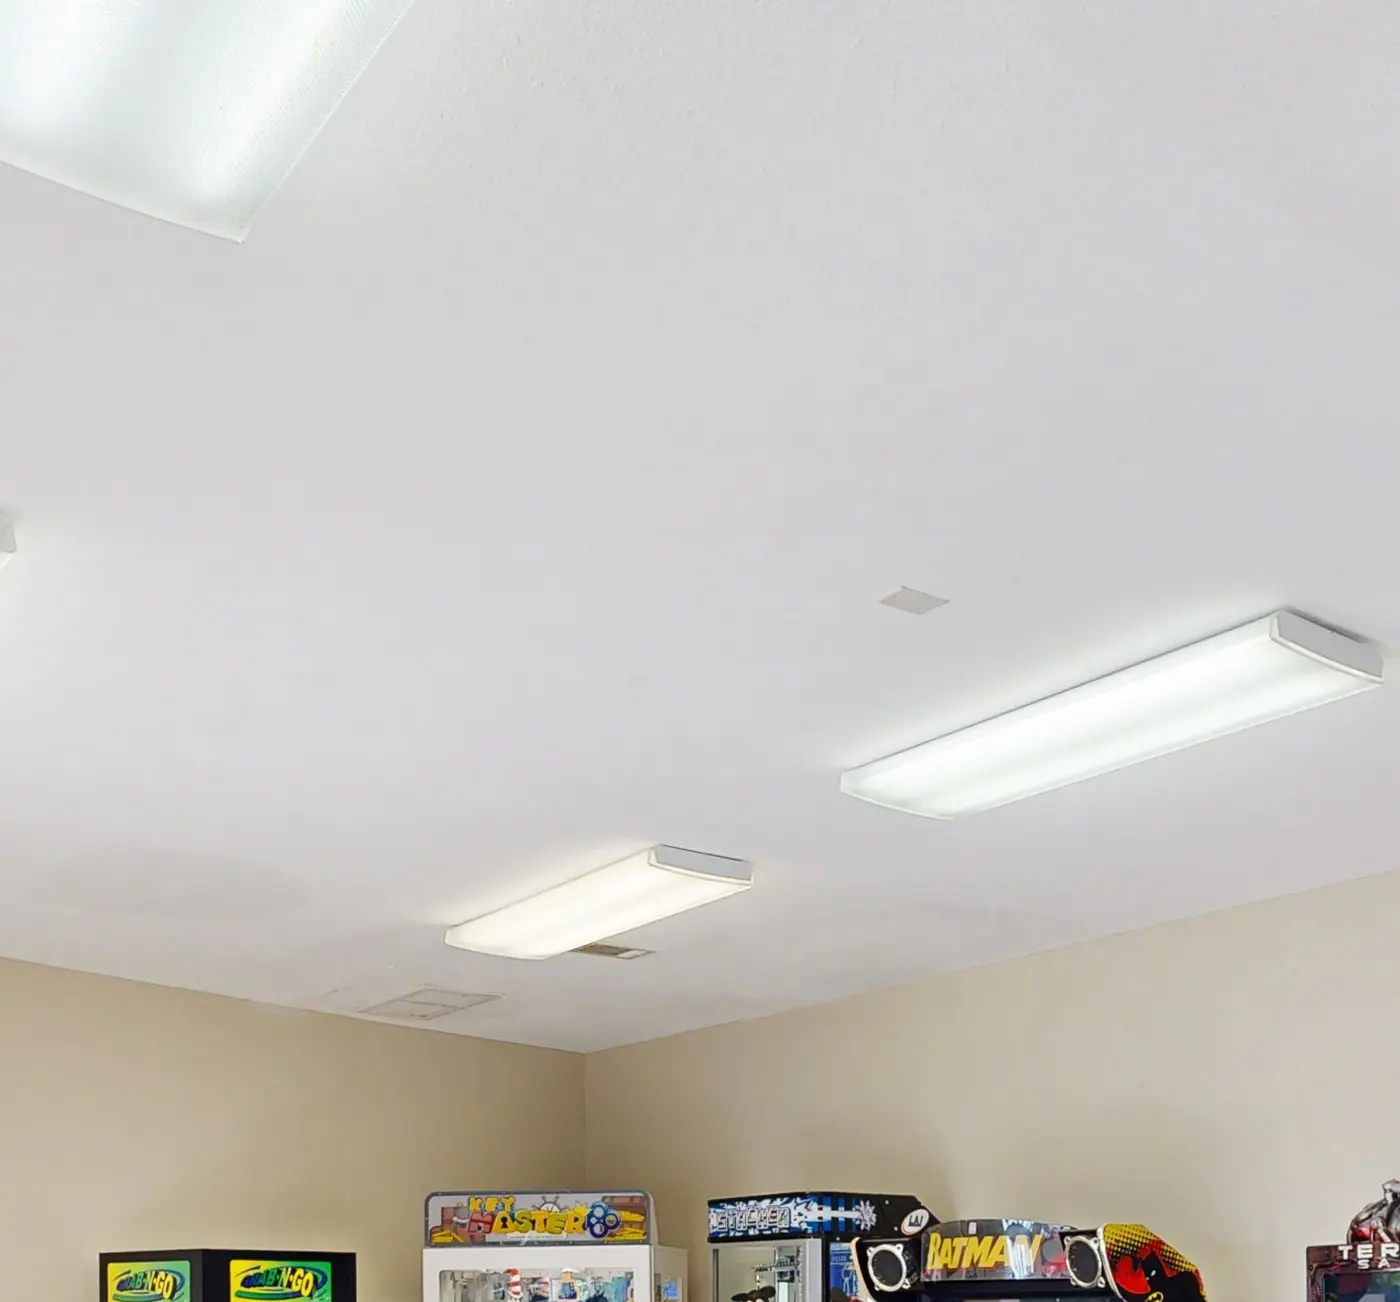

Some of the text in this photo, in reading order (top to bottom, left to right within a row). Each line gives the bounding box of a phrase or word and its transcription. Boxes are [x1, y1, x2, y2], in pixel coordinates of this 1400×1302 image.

[468, 1195, 515, 1213] KEY
[466, 1209, 586, 1234] MASTER
[716, 1206, 791, 1231] STACKER
[926, 1232, 1044, 1271] BATMAN
[1338, 1243, 1400, 1260] TER
